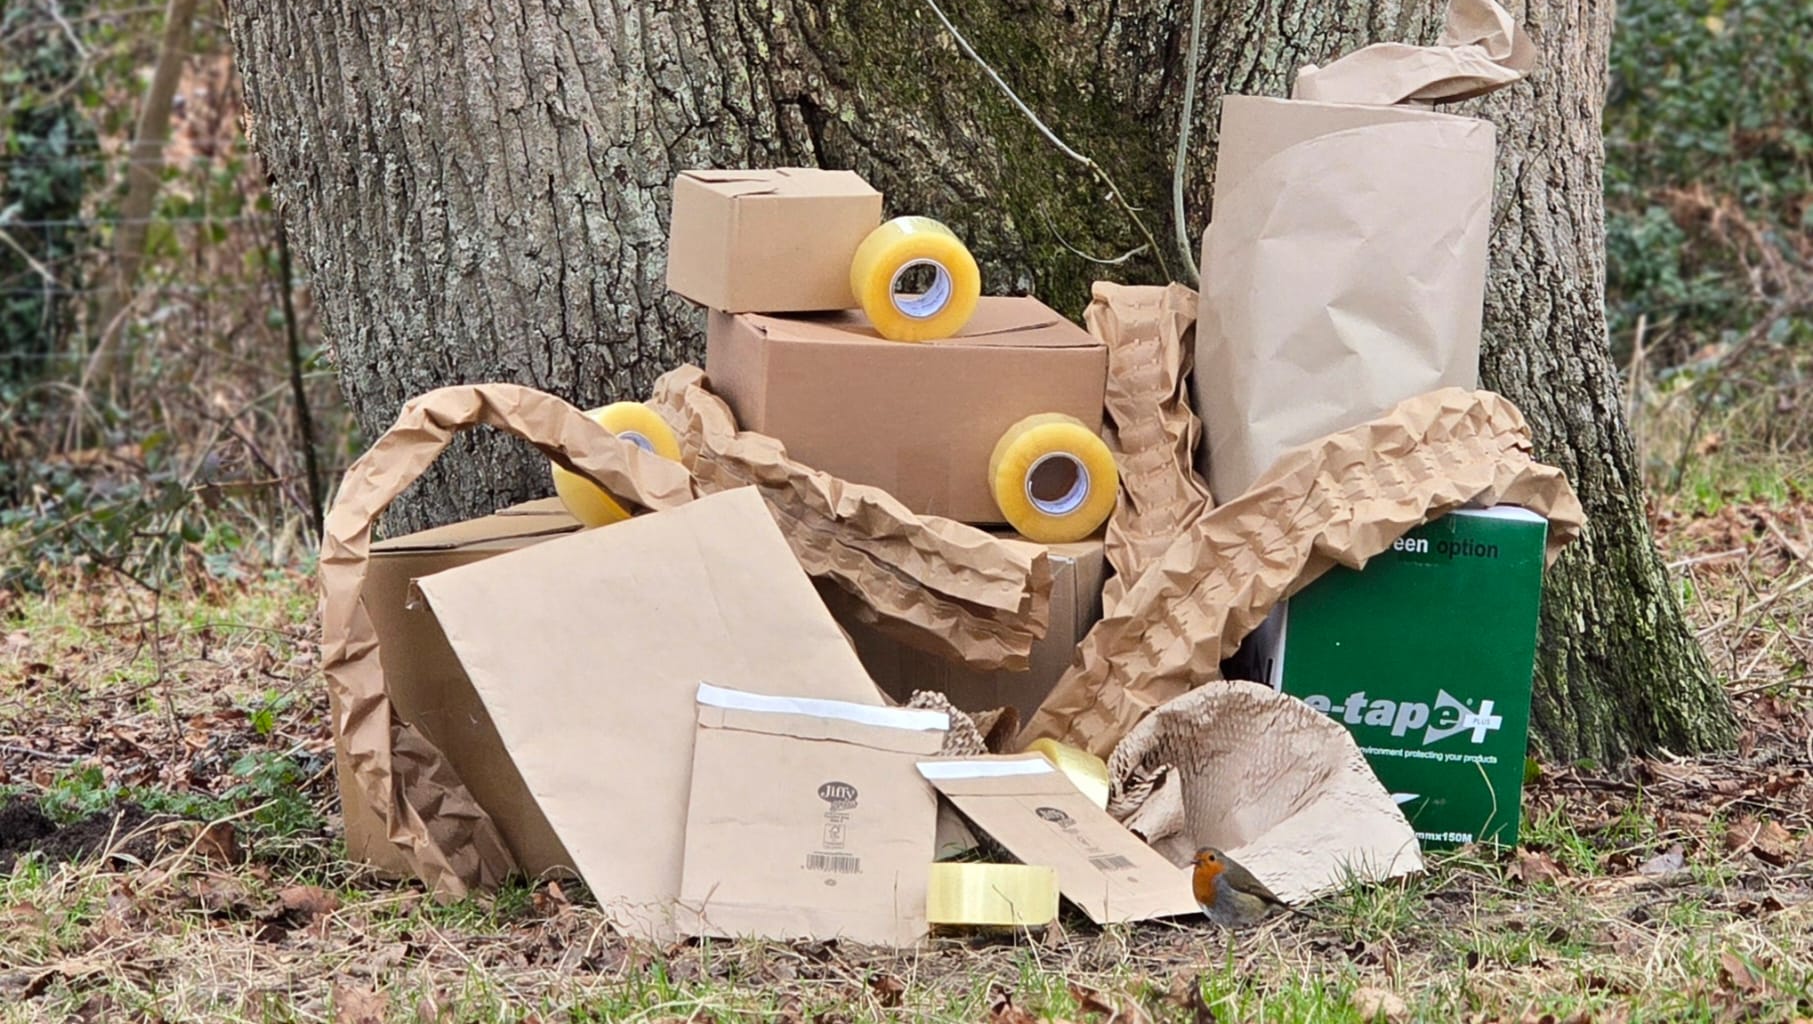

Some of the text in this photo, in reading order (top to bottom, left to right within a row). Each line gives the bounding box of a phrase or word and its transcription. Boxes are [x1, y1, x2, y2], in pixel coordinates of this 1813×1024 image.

[1393, 536, 1499, 559] een option
[1473, 716, 1491, 726] PLUS
[1359, 745, 1498, 765] nvironment protecting your products
[1415, 831, 1473, 843] mmx150M
